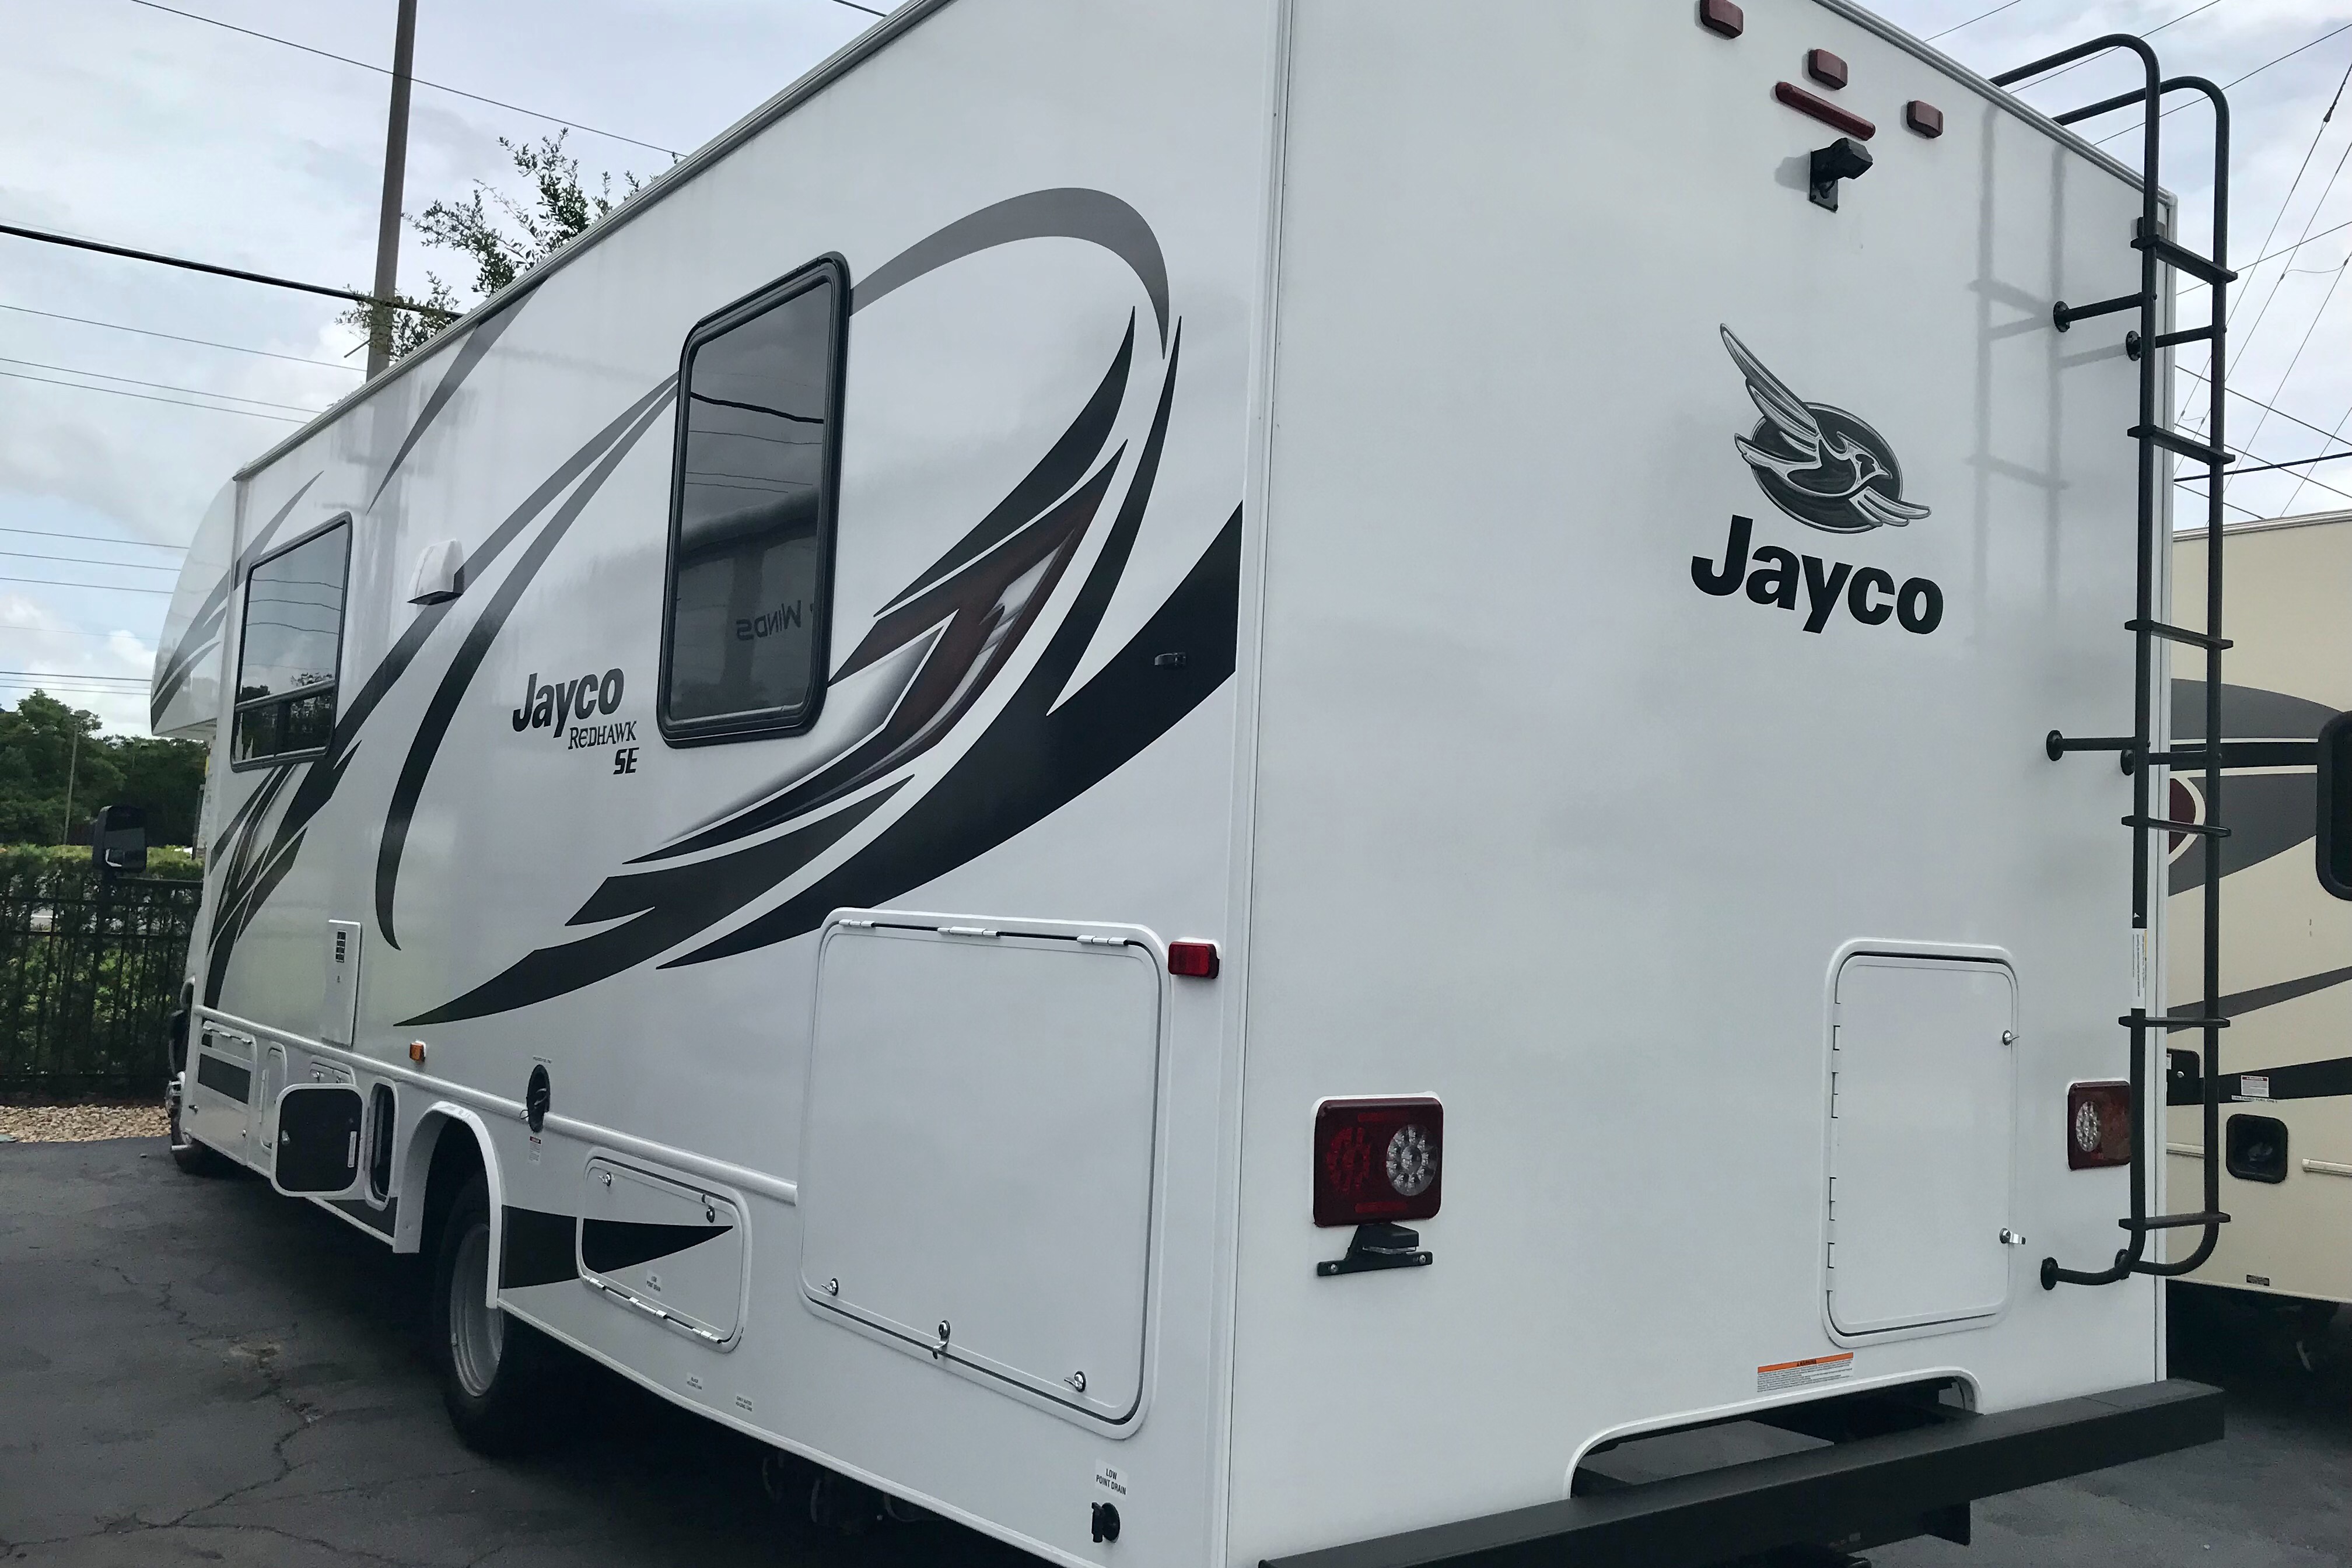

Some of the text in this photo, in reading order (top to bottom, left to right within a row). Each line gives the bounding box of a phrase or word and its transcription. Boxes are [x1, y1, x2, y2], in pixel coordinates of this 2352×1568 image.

[1690, 514, 1944, 635] Jayco
[513, 668, 625, 738] Jayco
[613, 747, 639, 775] SE
[1096, 1475, 1126, 1495] POINT DRAIN
[1106, 1468, 1117, 1480] LOW
